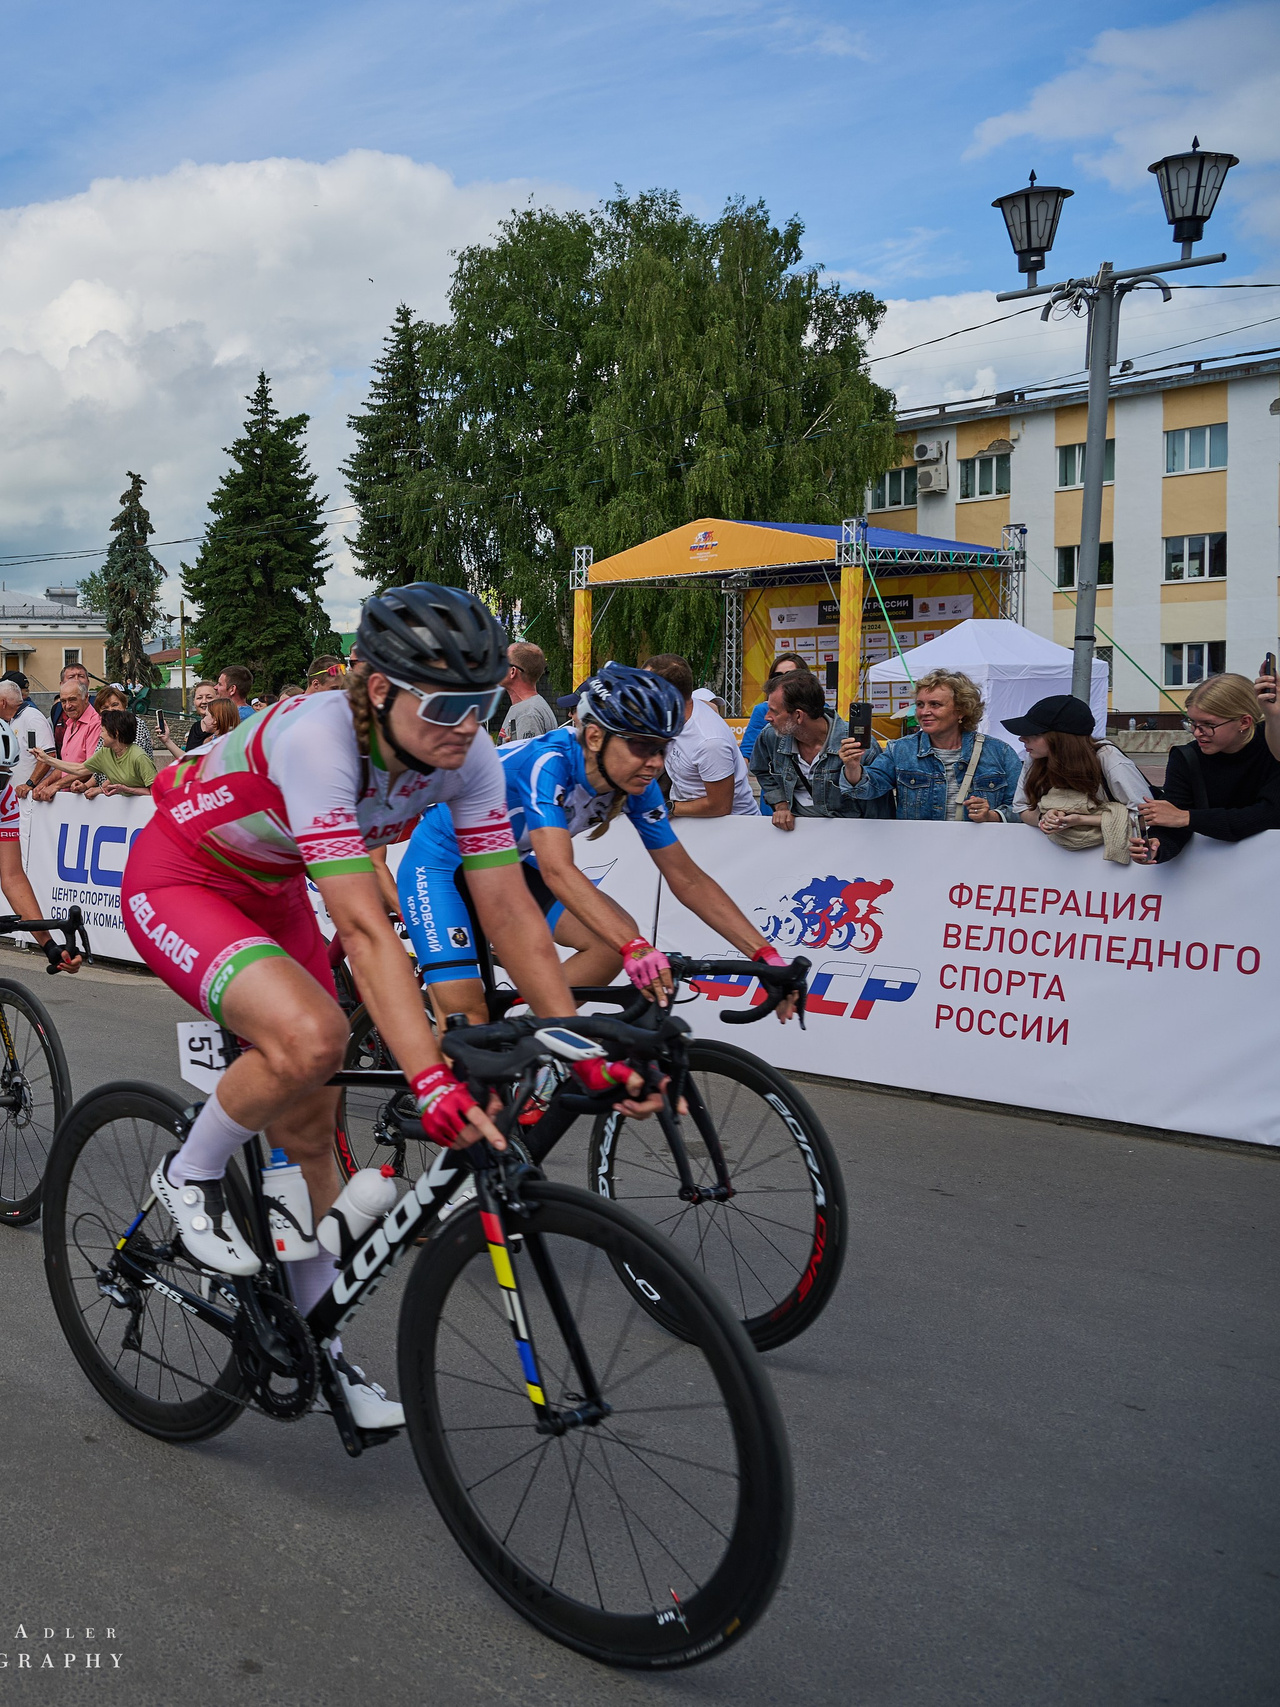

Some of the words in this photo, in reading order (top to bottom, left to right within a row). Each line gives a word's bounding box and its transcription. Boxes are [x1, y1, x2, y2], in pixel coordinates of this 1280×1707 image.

[170, 785, 235, 824] BELARUS
[52, 886, 78, 902] ЦЕНТР
[79, 890, 121, 908] СПОРТИВ
[406, 895, 420, 926] КРАЙ
[415, 866, 441, 953] ХАБАРОВСКИЙ
[948, 882, 1163, 923] ФЕДЕРАЦИЯ
[128, 892, 200, 974] BELARUS
[942, 922, 1262, 976] ВЕЛОСИПЕДНОГО
[938, 963, 1067, 1003] СПОРТА
[934, 1003, 1070, 1047] РОССИИ
[188, 1035, 223, 1071] 57
[763, 1092, 827, 1207] BORA
[332, 1148, 458, 1305] LOOK
[141, 1273, 184, 1305] 785
